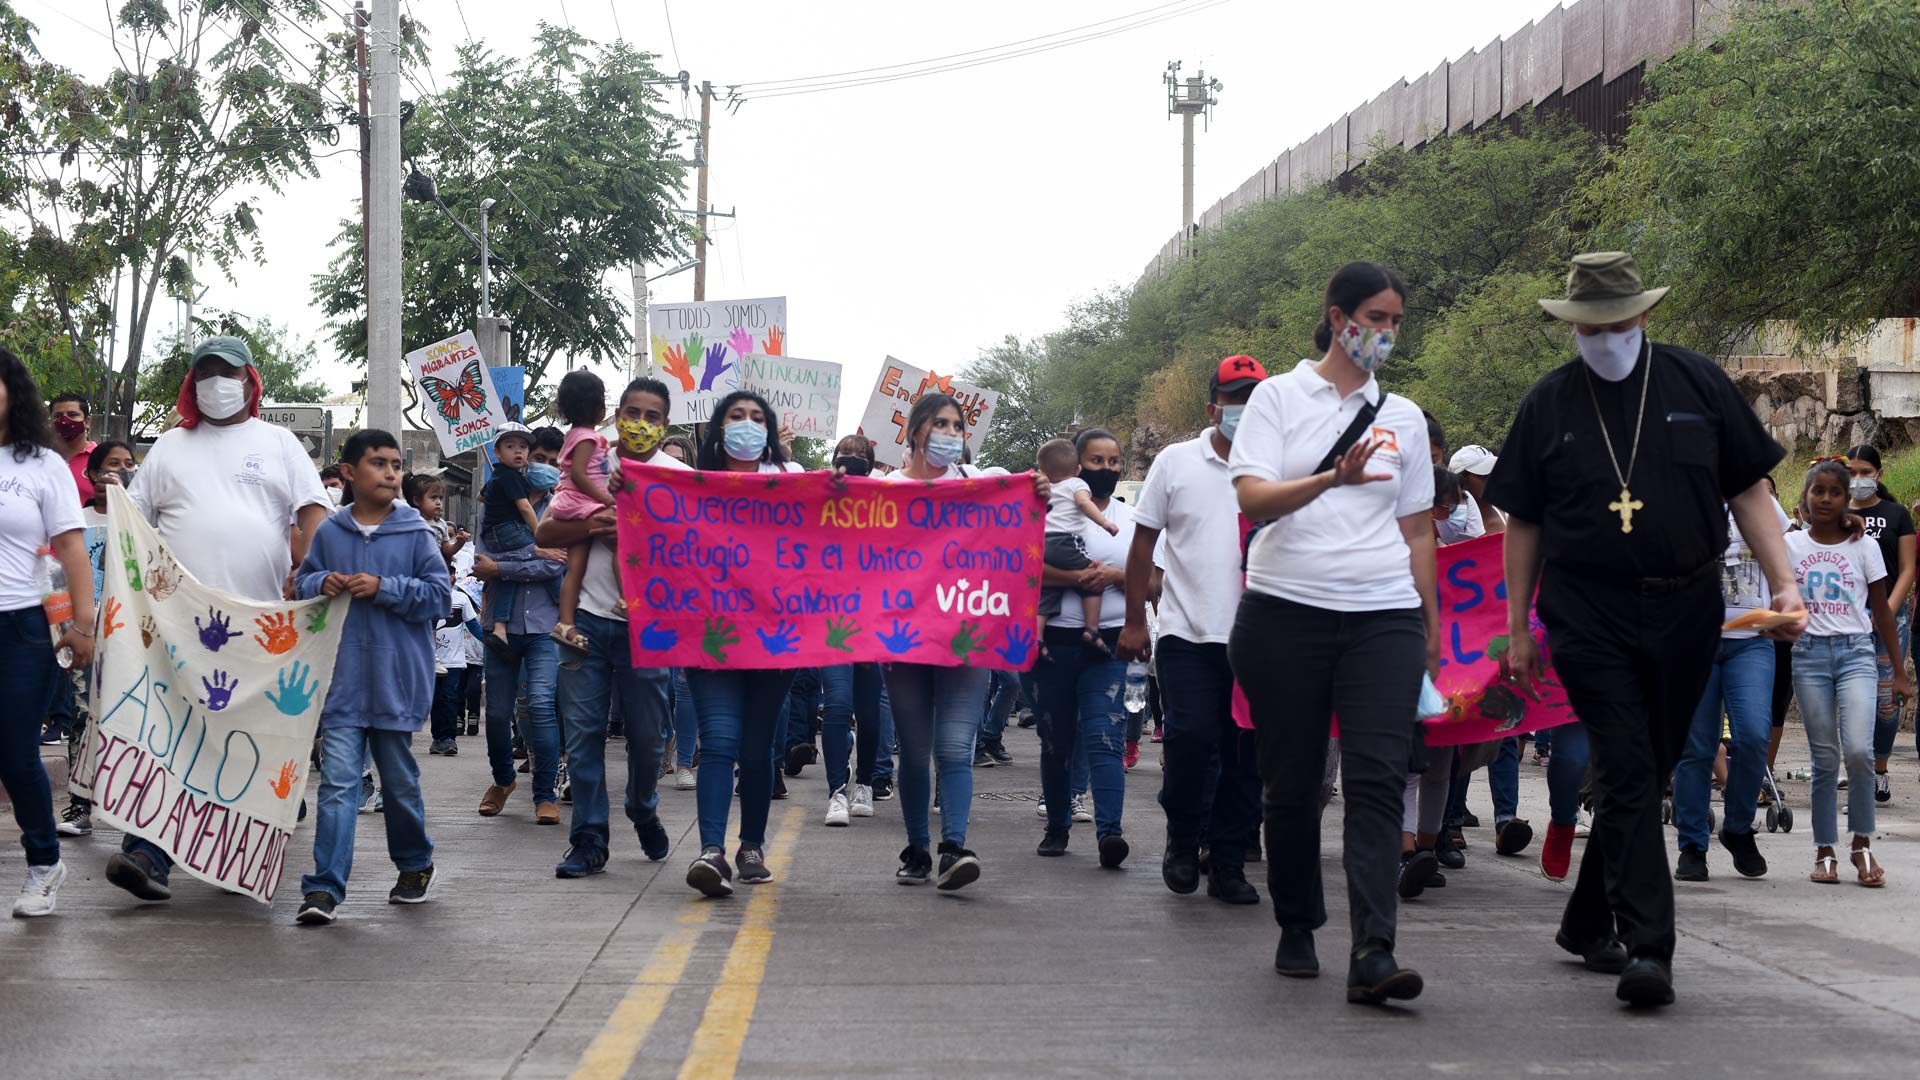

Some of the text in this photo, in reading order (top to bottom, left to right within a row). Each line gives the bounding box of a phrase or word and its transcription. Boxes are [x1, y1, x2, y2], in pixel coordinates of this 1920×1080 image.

[658, 306, 711, 330] TODOS
[723, 304, 767, 328] SOMOS
[421, 346, 477, 376] MIGRANTES
[425, 340, 462, 360] SOMOS
[880, 366, 928, 404] End
[260, 413, 296, 423] DALGO
[455, 417, 490, 437] SOMOS
[246, 461, 260, 469] 66
[644, 484, 806, 527] Queremos
[906, 497, 1023, 530] Queremos
[1865, 517, 1887, 528] RO
[648, 528, 750, 583] Refugio
[776, 537, 809, 569] Es
[858, 544, 923, 572] Unico
[942, 540, 1023, 573] Camino
[644, 576, 701, 612] Que
[711, 587, 756, 613] nos
[1808, 571, 1841, 600] PS
[1821, 602, 1850, 615] YORK
[101, 665, 260, 804] ASILO
